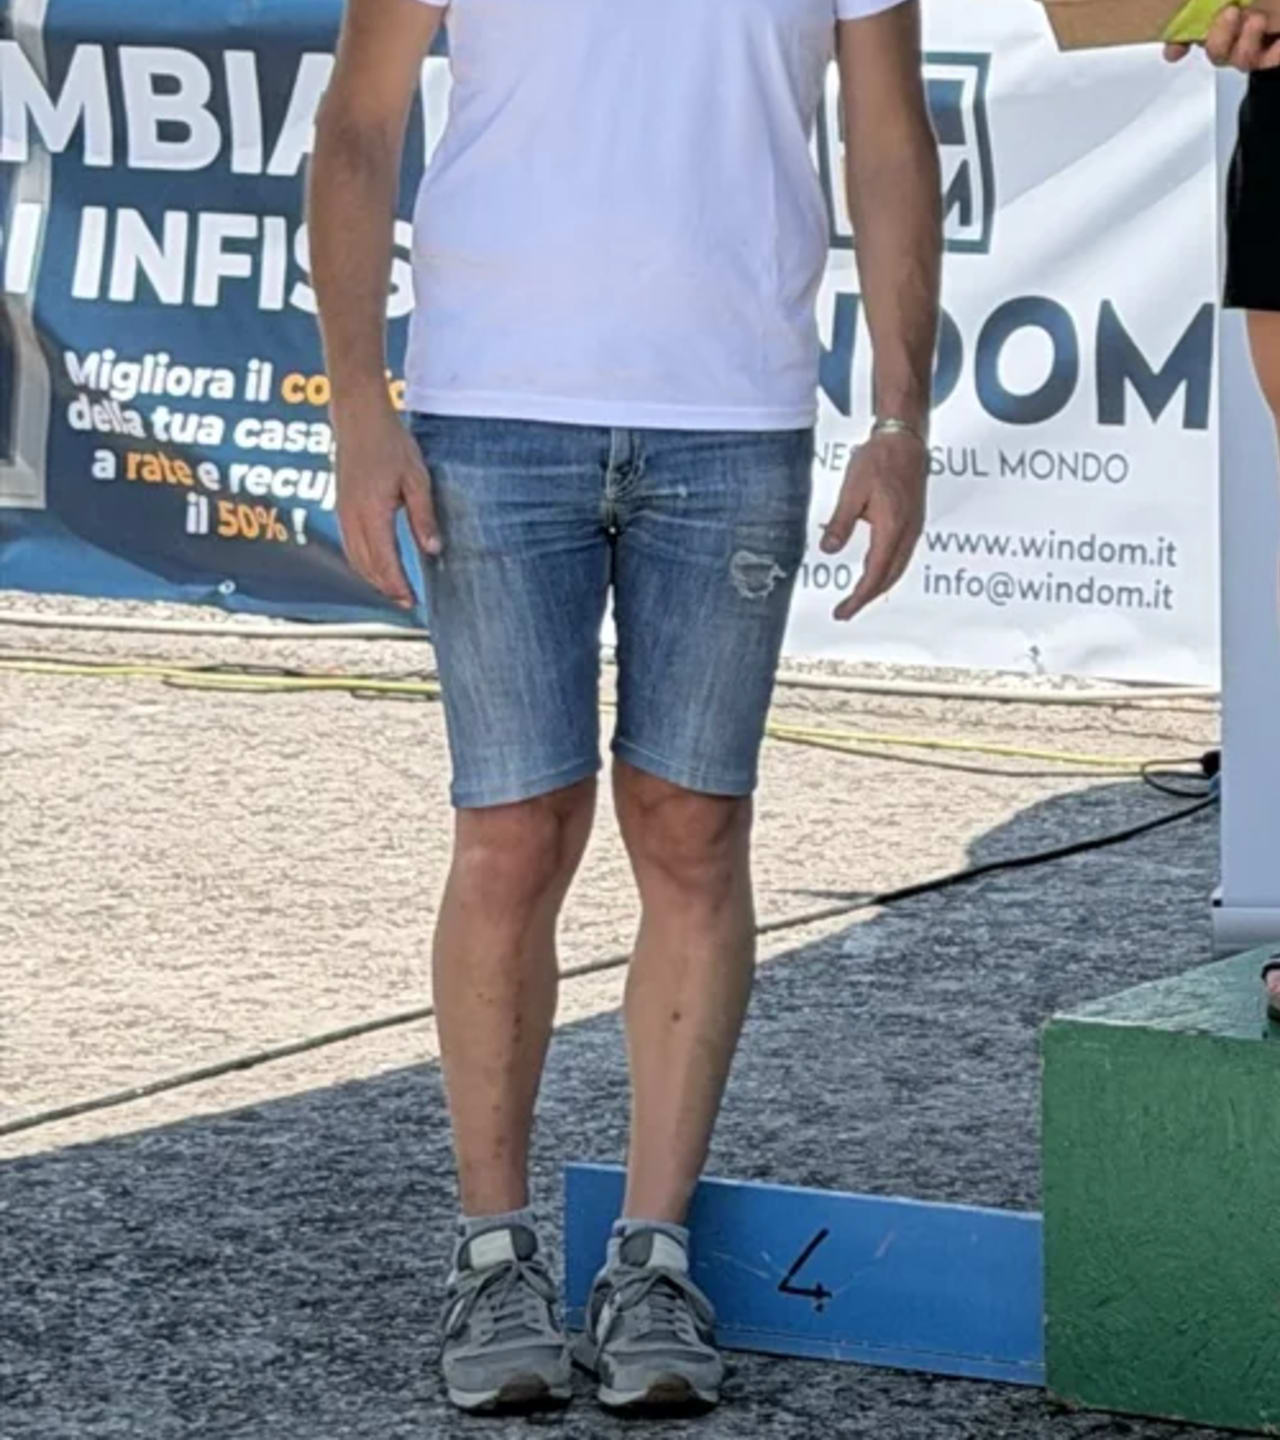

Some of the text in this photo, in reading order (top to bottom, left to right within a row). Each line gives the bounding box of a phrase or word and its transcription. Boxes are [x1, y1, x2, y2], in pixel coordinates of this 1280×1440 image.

[64, 349, 236, 402] Migliora
[244, 358, 273, 402] il
[67, 393, 147, 439] della
[151, 405, 224, 446] tua
[91, 448, 116, 480] a
[125, 450, 195, 486] rate
[197, 461, 221, 491] e
[999, 449, 1130, 484] MONDO
[186, 491, 208, 535] il
[926, 530, 1178, 568] www.windom.it
[924, 565, 1175, 611] info@windom.it
[778, 1227, 833, 1314] 4
